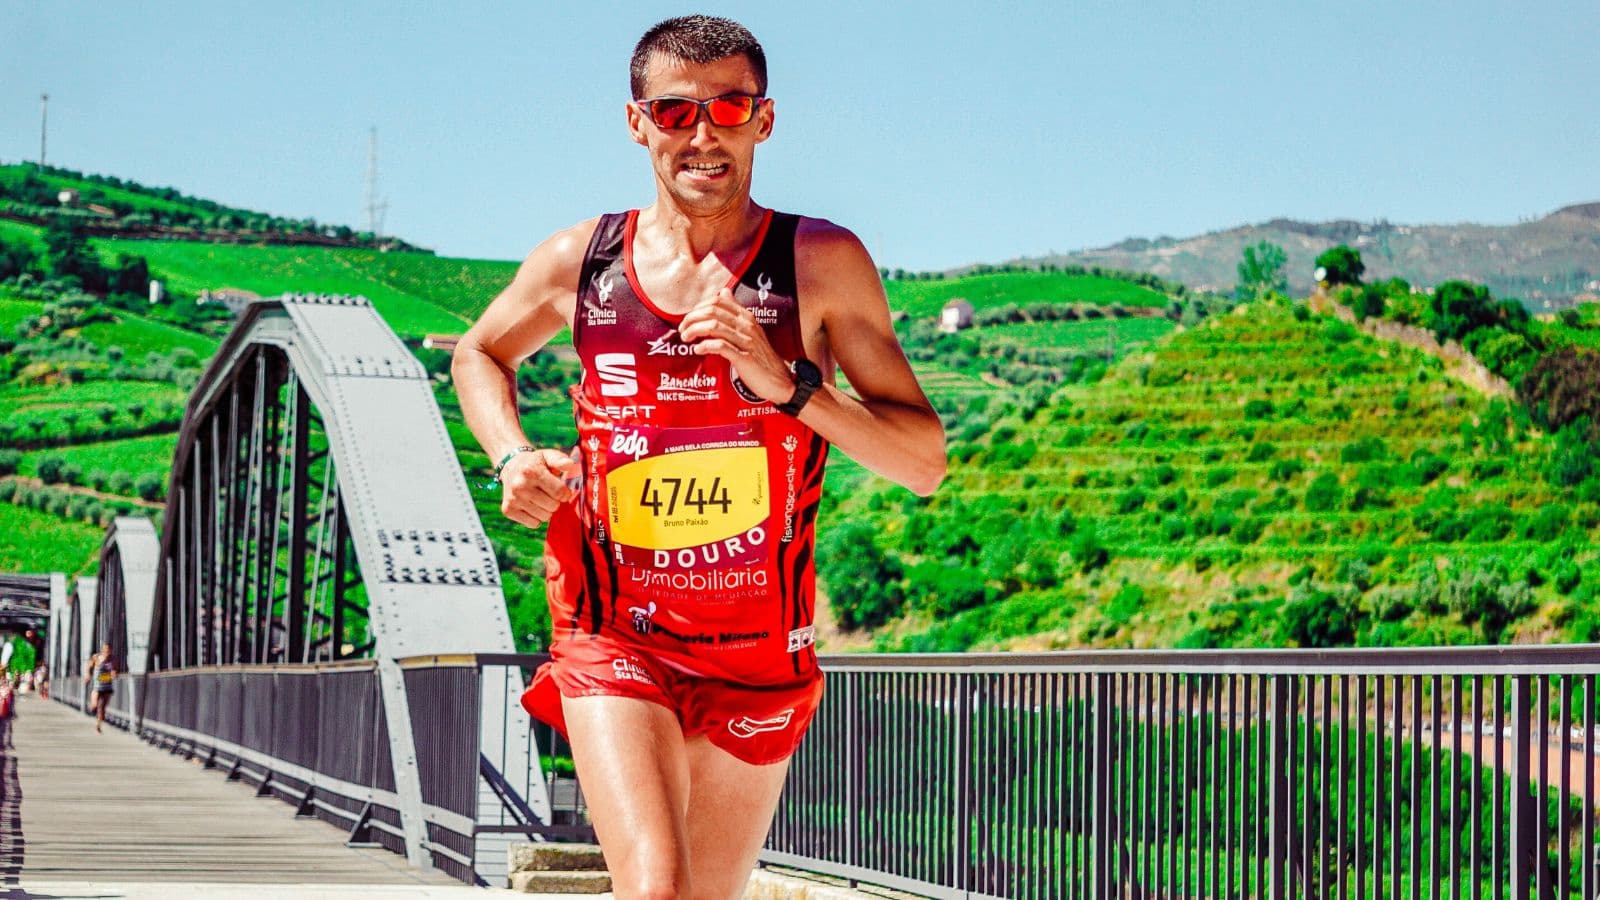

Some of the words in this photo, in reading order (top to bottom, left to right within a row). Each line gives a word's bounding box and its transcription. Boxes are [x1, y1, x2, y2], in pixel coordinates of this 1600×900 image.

[611, 429, 649, 461] edp
[685, 443, 701, 451] BELA
[738, 440, 760, 448] MUNDO
[640, 477, 732, 516] 4744
[686, 518, 708, 526] Paixão
[654, 526, 765, 568] DOURO
